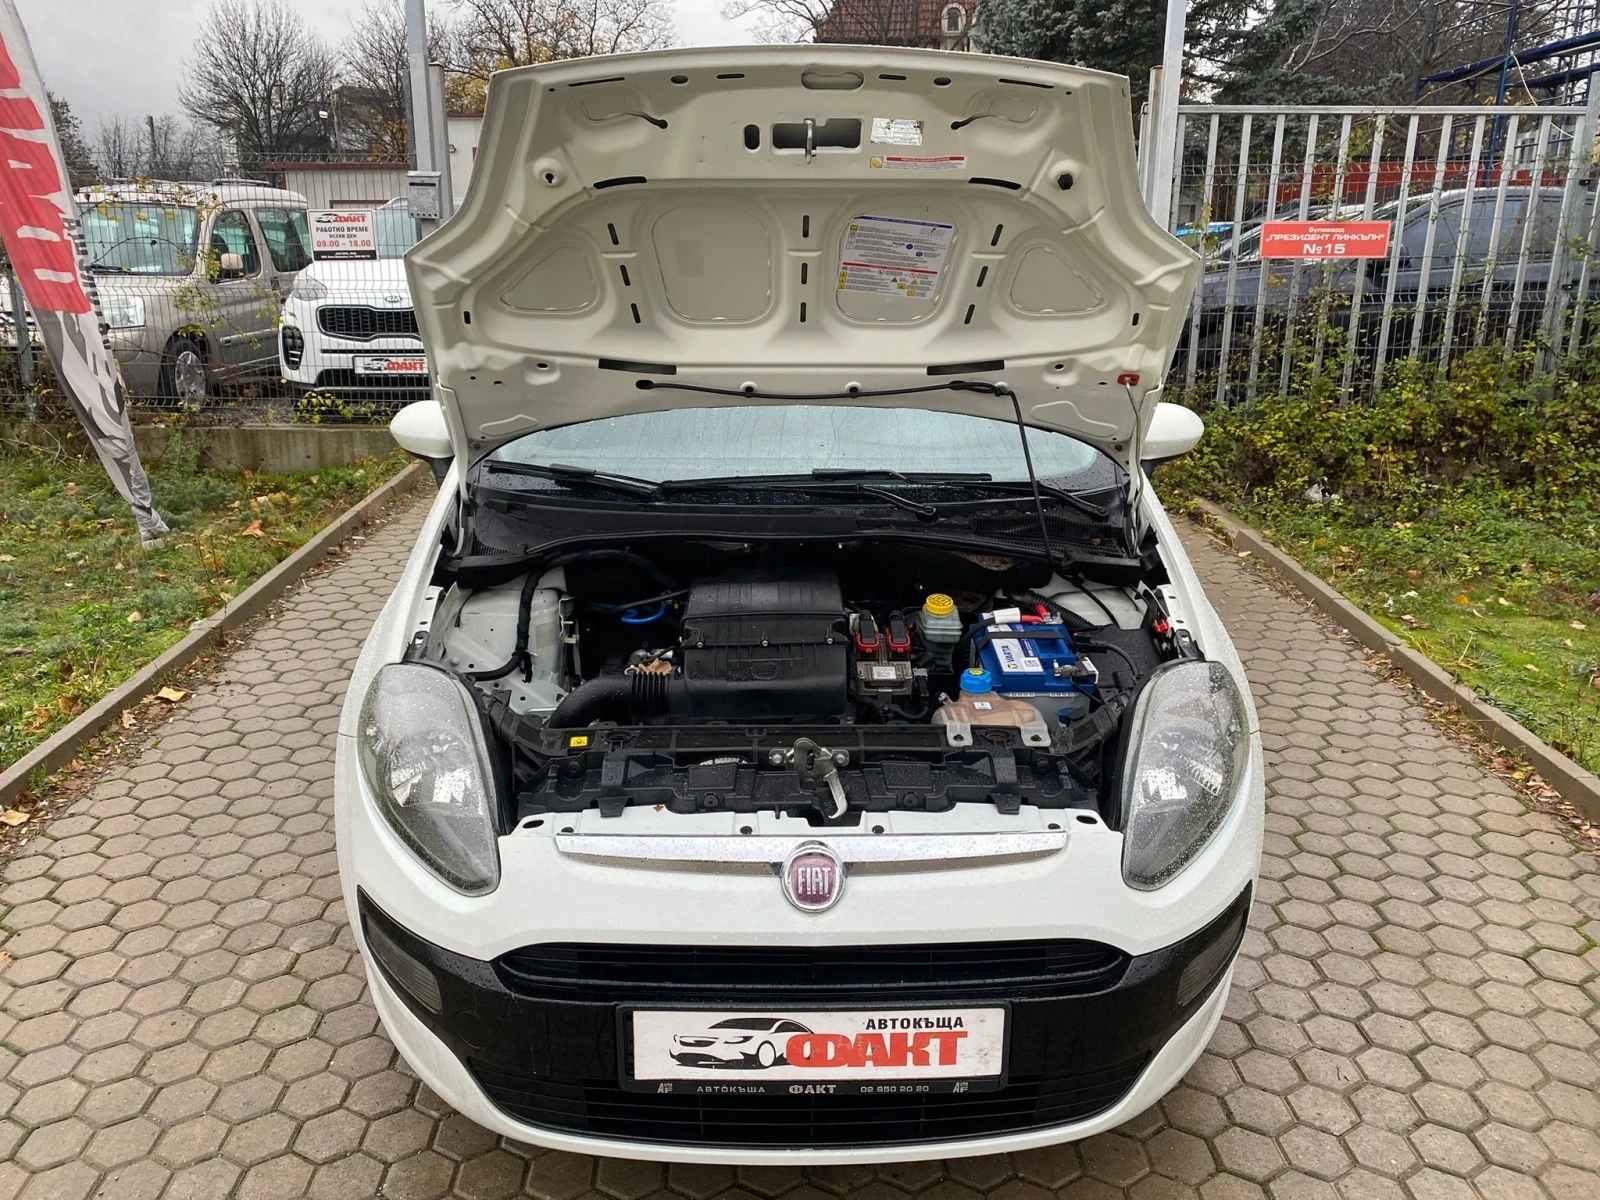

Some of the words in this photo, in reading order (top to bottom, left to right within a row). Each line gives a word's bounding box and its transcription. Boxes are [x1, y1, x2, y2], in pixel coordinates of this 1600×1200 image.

[1001, 645, 1015, 663] VARTA
[798, 867, 831, 894] FIAT
[866, 1017, 964, 1030] АВТОКЪЩА
[786, 1031, 968, 1067] ФАКТ
[789, 1084, 837, 1094] ФАКТ
